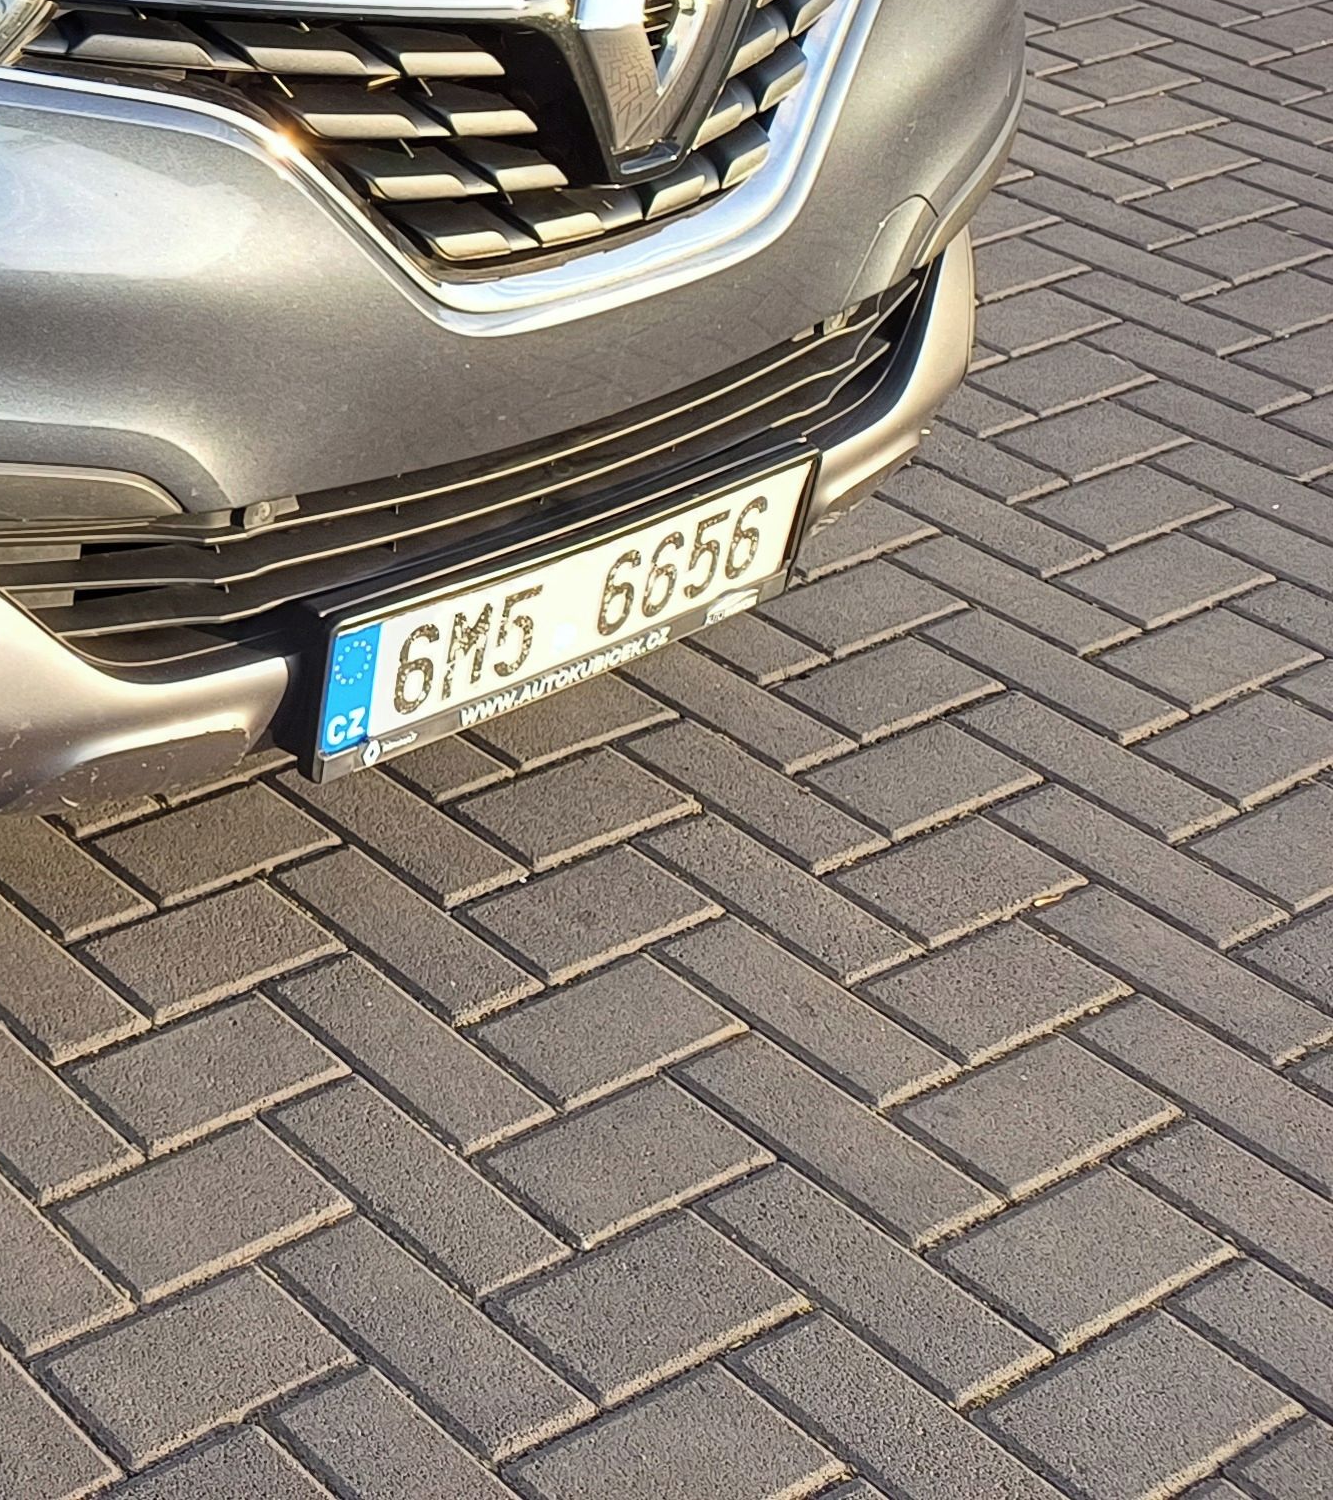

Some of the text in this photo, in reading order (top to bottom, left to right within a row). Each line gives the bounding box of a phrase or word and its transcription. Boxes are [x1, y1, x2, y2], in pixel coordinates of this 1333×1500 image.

[393, 495, 768, 715] 6M5 6656
[326, 706, 366, 746] CZ
[459, 625, 673, 727] WWW.AUTOKUBICEK.CZ
